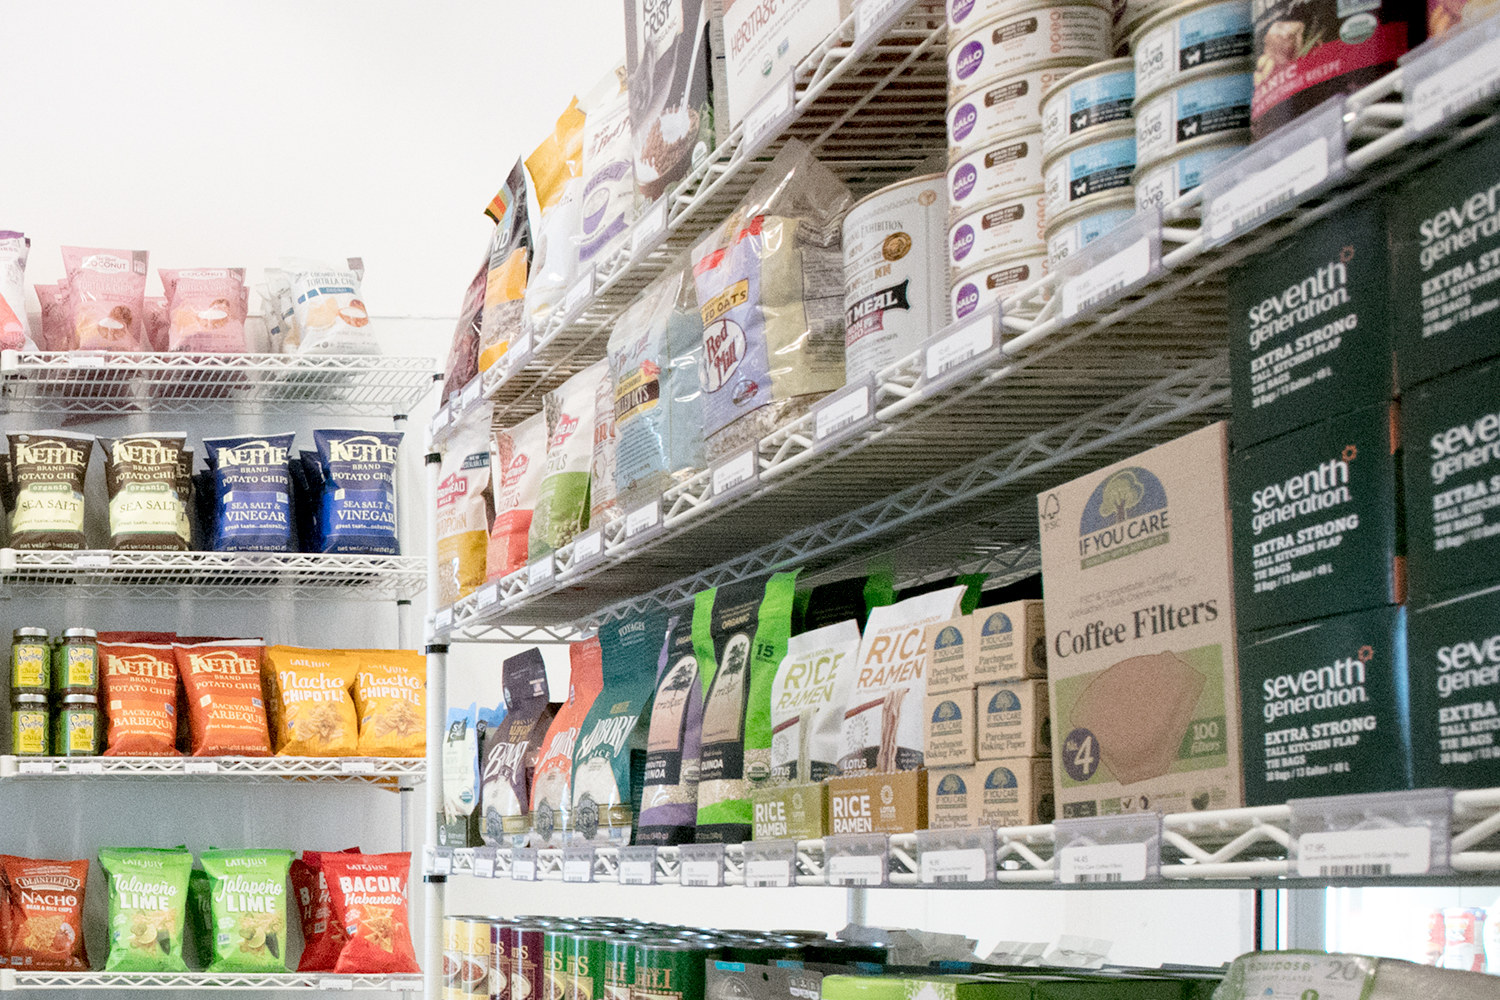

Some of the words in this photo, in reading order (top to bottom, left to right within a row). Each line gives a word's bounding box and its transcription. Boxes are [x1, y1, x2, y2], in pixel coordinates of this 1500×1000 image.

[717, 289, 747, 311] OATS
[1249, 261, 1347, 330] seventh
[1249, 286, 1349, 350] generation
[707, 318, 730, 353] Red
[1251, 340, 1294, 372] EXTRA
[1295, 313, 1357, 352] STRONG
[714, 339, 738, 373] Mill
[1252, 364, 1272, 384] TALL
[15, 440, 86, 466] KETTLE
[111, 439, 178, 466] KETTLE
[217, 440, 290, 468] KETTLE
[18, 472, 53, 482] POTATO
[222, 473, 258, 486] POTATO
[260, 475, 289, 485] CHIPS
[1252, 459, 1348, 514] seventh
[32, 483, 71, 493] organic
[129, 484, 166, 493] organic
[22, 500, 48, 512] SEA
[1252, 484, 1352, 535] generation
[225, 510, 287, 523] VINEGAR
[337, 510, 394, 523] VINEGAR
[1079, 539, 1092, 556] IF
[1094, 525, 1125, 552] YOU
[1128, 510, 1169, 538] CARE
[1252, 533, 1295, 558] EXTRA
[1297, 514, 1359, 545] STRONG
[1055, 619, 1126, 659] Coffee
[1133, 599, 1218, 641] Filters
[756, 643, 774, 658] 15
[978, 652, 1017, 667] Parchment
[279, 670, 344, 690] Nacho
[357, 670, 422, 689] Nacho
[784, 652, 845, 689] RICE
[857, 658, 925, 688] RAMEN
[1263, 658, 1365, 702] seventh
[283, 688, 345, 703] CHIPOTLE
[775, 683, 834, 709] RAMEN
[1264, 684, 1368, 723] generation
[122, 709, 167, 719] BACKYARD
[212, 703, 256, 714] BACKYARD
[985, 730, 1022, 744] Parchment
[1193, 722, 1218, 741] 100
[1264, 724, 1309, 746] EXTRA
[1311, 716, 1376, 737] STRONG
[1074, 739, 1094, 773] 4
[1266, 743, 1287, 757] TALL
[844, 758, 868, 771] LOTUS
[755, 801, 786, 821] RICE
[832, 795, 870, 817] RICE
[756, 819, 787, 836] RAMEN
[833, 815, 873, 833] RAMEN
[340, 876, 401, 894] BACON
[20, 892, 77, 906] NACHO
[120, 893, 170, 911] LIME
[226, 895, 276, 914] LIME
[344, 892, 402, 906] Habanero
